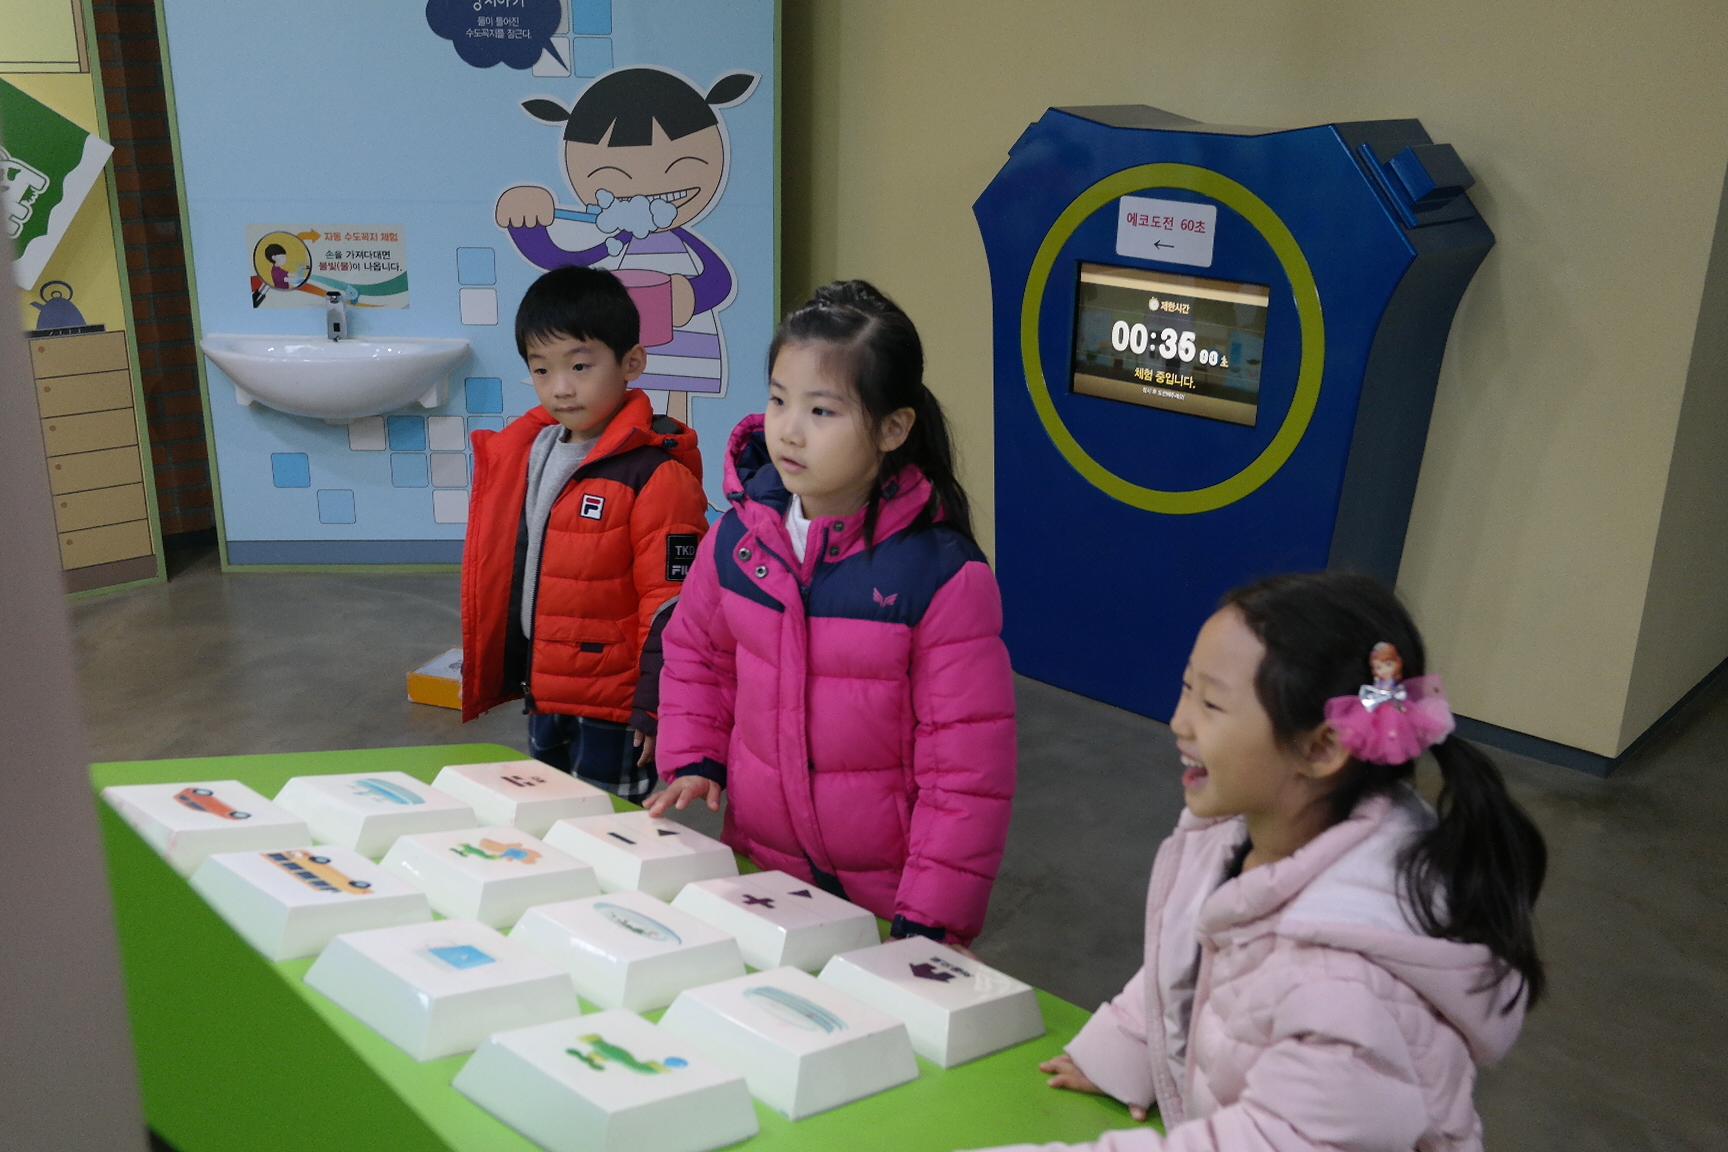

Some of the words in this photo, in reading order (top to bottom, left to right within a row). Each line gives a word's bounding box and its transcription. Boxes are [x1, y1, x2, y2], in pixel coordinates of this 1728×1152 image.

[1127, 212, 1174, 230] 에코도전
[1180, 219, 1206, 234] 60초
[324, 232, 341, 241] 자동
[344, 232, 378, 242] 수도꼭지
[380, 232, 398, 242] 체험
[325, 250, 342, 259] 손을
[346, 250, 390, 260] 가져다대면
[364, 262, 402, 272] 나옵니다.
[1160, 300, 1190, 314] 제한시간
[1134, 367, 1152, 382] 체험
[1155, 370, 1196, 389] 중입니다.
[675, 546, 696, 556] TKD
[672, 564, 689, 576] FIL
